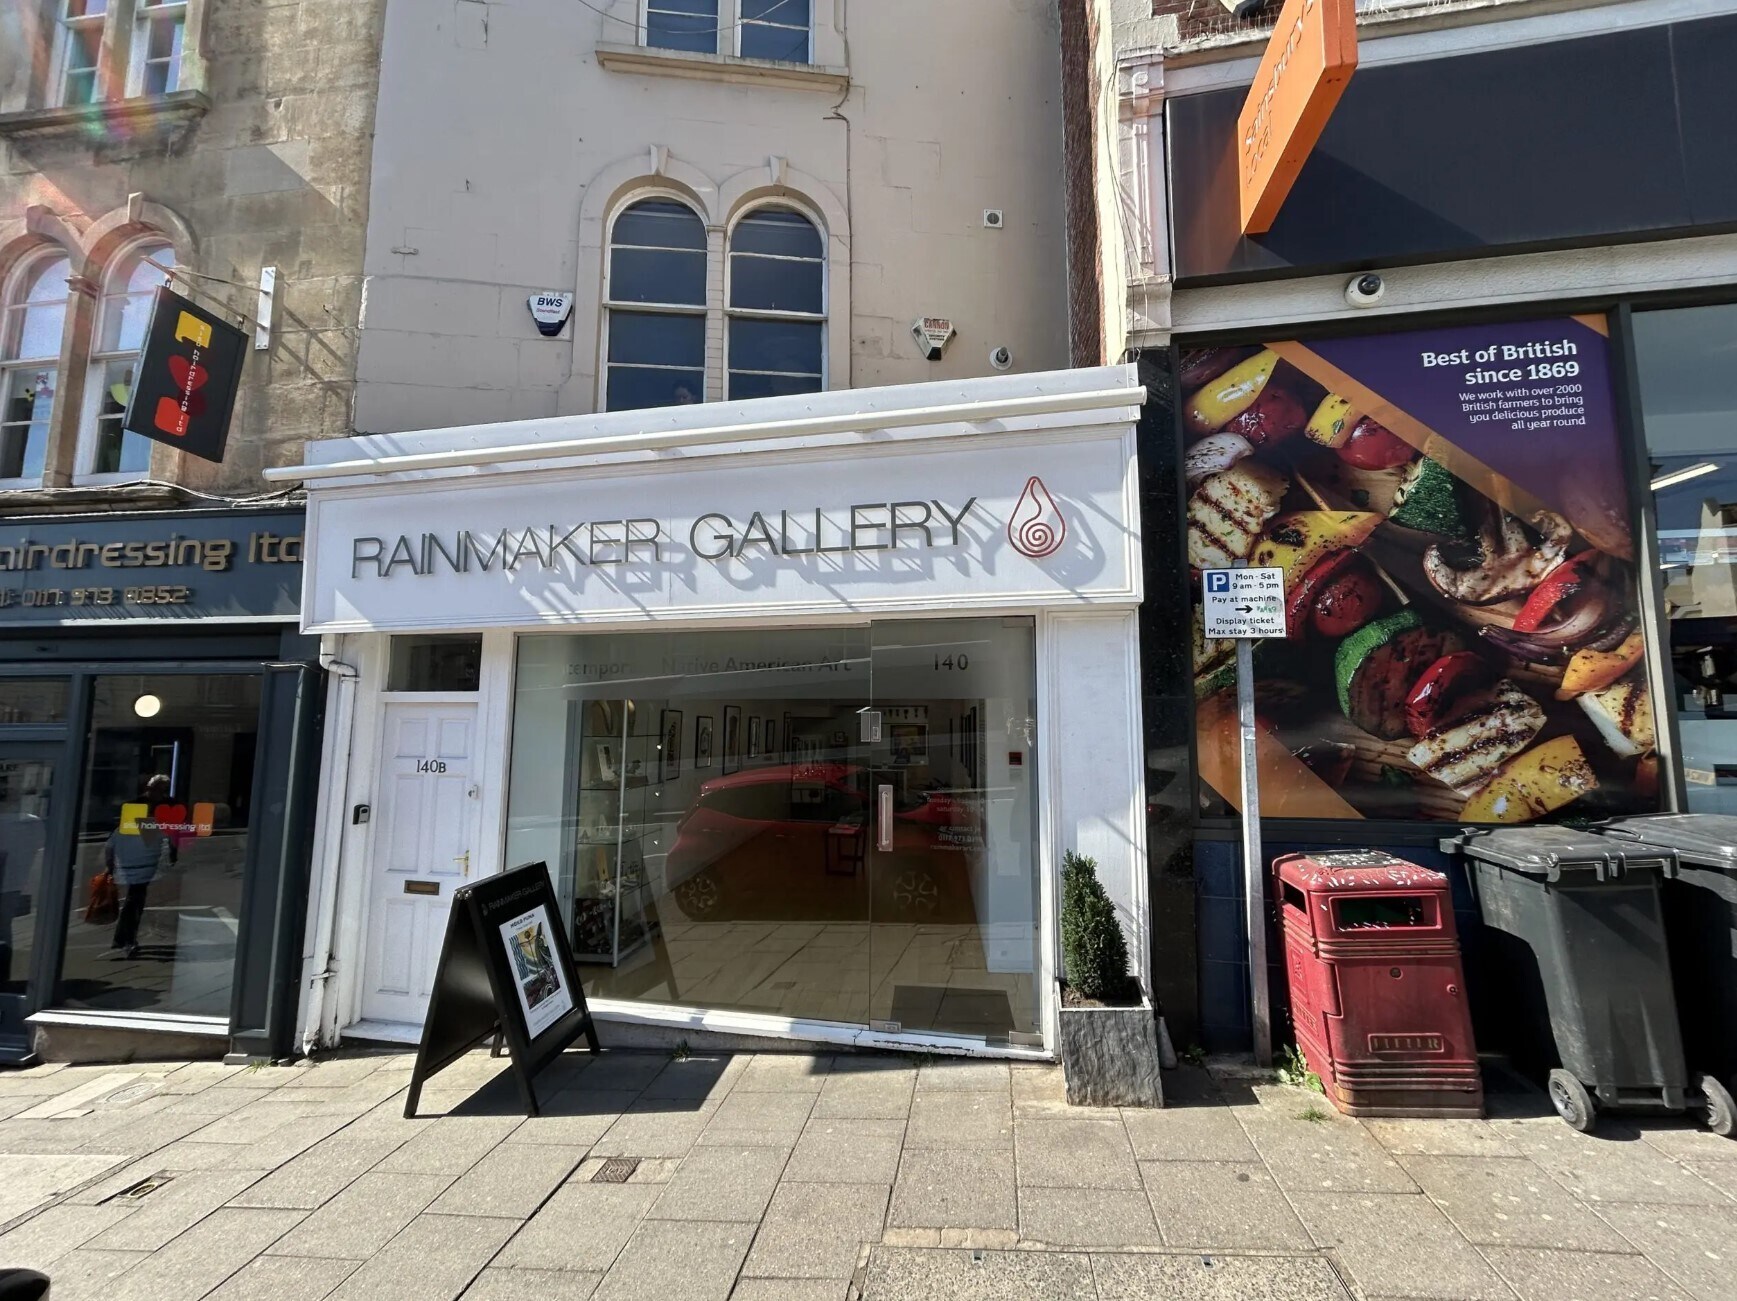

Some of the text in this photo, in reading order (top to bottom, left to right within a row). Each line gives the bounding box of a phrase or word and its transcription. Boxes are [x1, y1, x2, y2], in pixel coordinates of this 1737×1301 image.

[537, 297, 563, 308] BWS
[1422, 339, 1577, 367] Best of British
[1465, 361, 1580, 385] since 1869
[1459, 384, 1582, 401] We work with over 2000
[1462, 395, 1583, 412] British farmers to bring
[1469, 406, 1584, 424] you delicious produce
[1511, 416, 1586, 431] all year round
[352, 497, 977, 579] RAINMAKER GALLERY
[248, 531, 305, 563] ltd
[1260, 572, 1276, 580] Sat
[22, 588, 60, 606] 0117
[71, 587, 114, 605] 973
[1212, 596, 1227, 604] Pay
[818, 655, 852, 671] Art
[934, 653, 969, 670] 140
[416, 759, 447, 773] 140B
[141, 821, 197, 832] hairdressing
